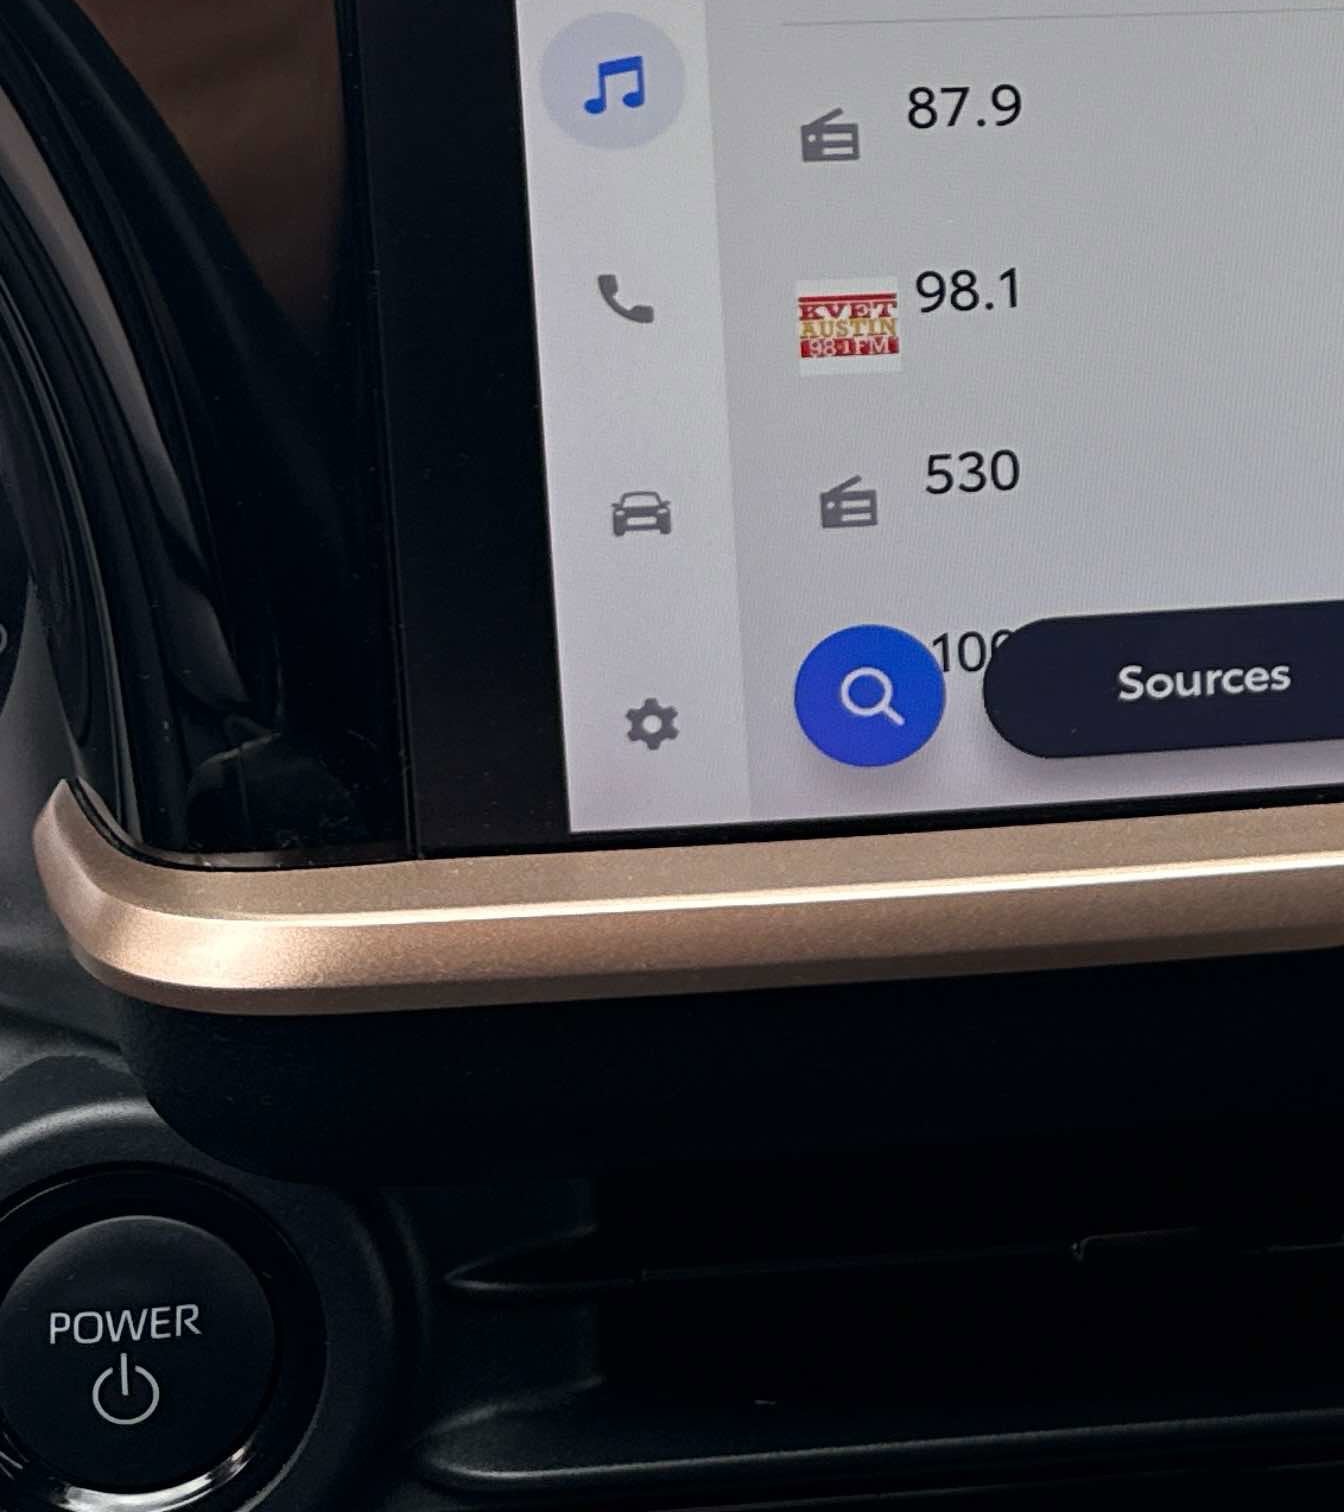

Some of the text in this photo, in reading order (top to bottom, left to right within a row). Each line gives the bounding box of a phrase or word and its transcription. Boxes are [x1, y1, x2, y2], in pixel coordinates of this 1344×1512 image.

[908, 84, 1022, 129] 87.9
[915, 267, 1018, 313] 98.1
[800, 318, 897, 338] AUSTIN
[926, 449, 1021, 495] 530
[1118, 664, 1292, 702] Sources
[49, 1303, 202, 1345] POWER
